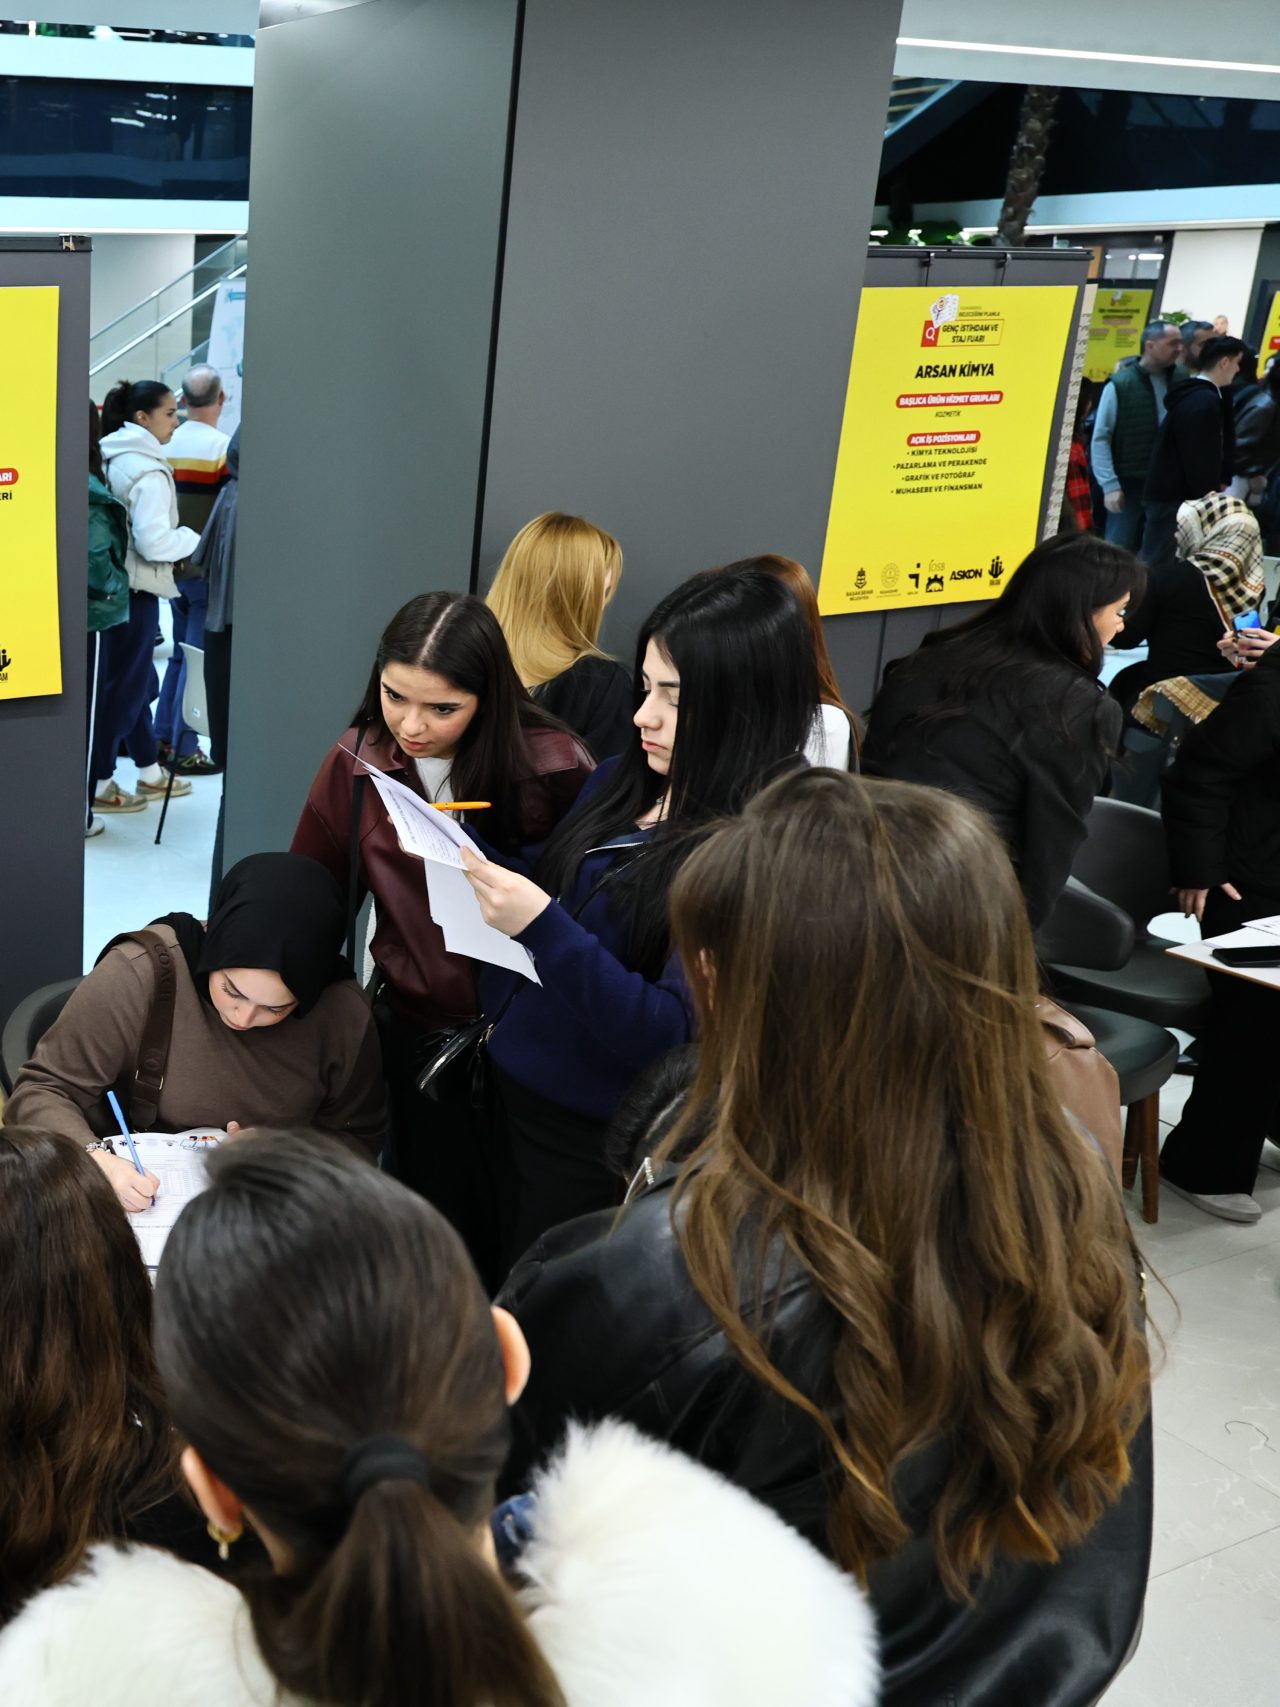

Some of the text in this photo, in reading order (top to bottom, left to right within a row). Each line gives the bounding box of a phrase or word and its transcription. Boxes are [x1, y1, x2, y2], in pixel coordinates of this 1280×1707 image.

[942, 325, 959, 334] GENÇ
[915, 361, 994, 378] ARSAN KİMYA
[911, 448, 932, 456] KİMYA
[896, 461, 937, 469] PAZARLAMA
[948, 458, 987, 466] PERAKENDE
[905, 473, 929, 481] GRAFİK
[941, 471, 975, 479] FOTOĞRAF
[896, 486, 932, 494] MUHASEBE
[944, 483, 982, 491] FİNANSMAN
[950, 569, 983, 581] ASKON
